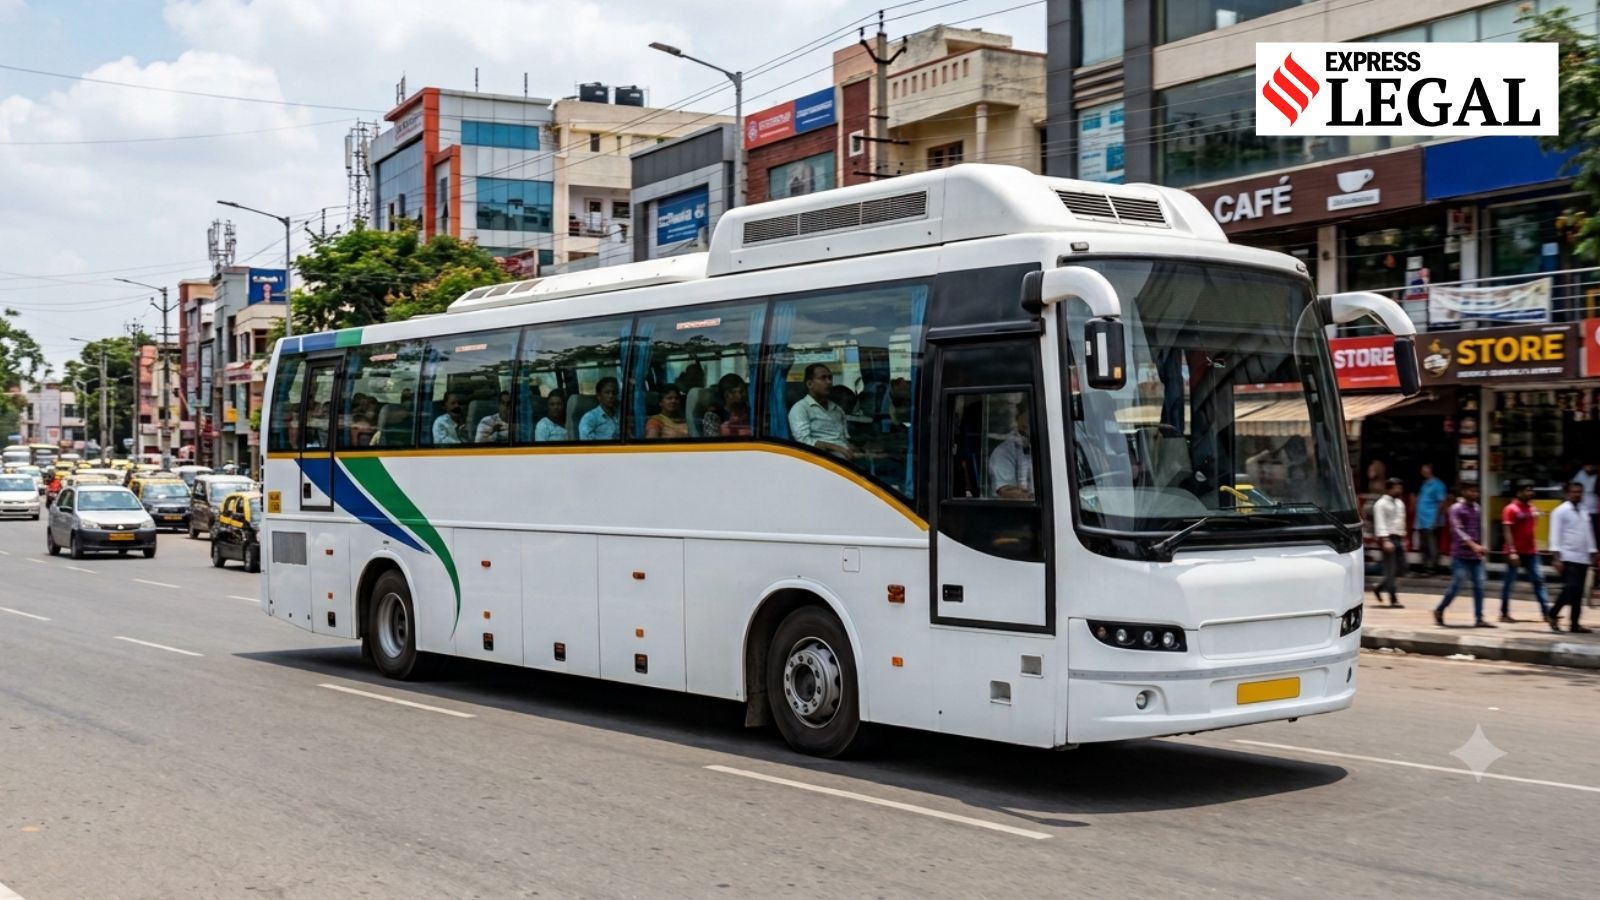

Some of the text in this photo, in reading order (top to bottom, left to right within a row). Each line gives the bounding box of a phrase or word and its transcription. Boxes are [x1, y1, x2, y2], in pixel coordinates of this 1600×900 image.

[1214, 175, 1293, 223] CAFÉ
[1333, 346, 1396, 370] STORE
[1456, 333, 1565, 366] STORE
